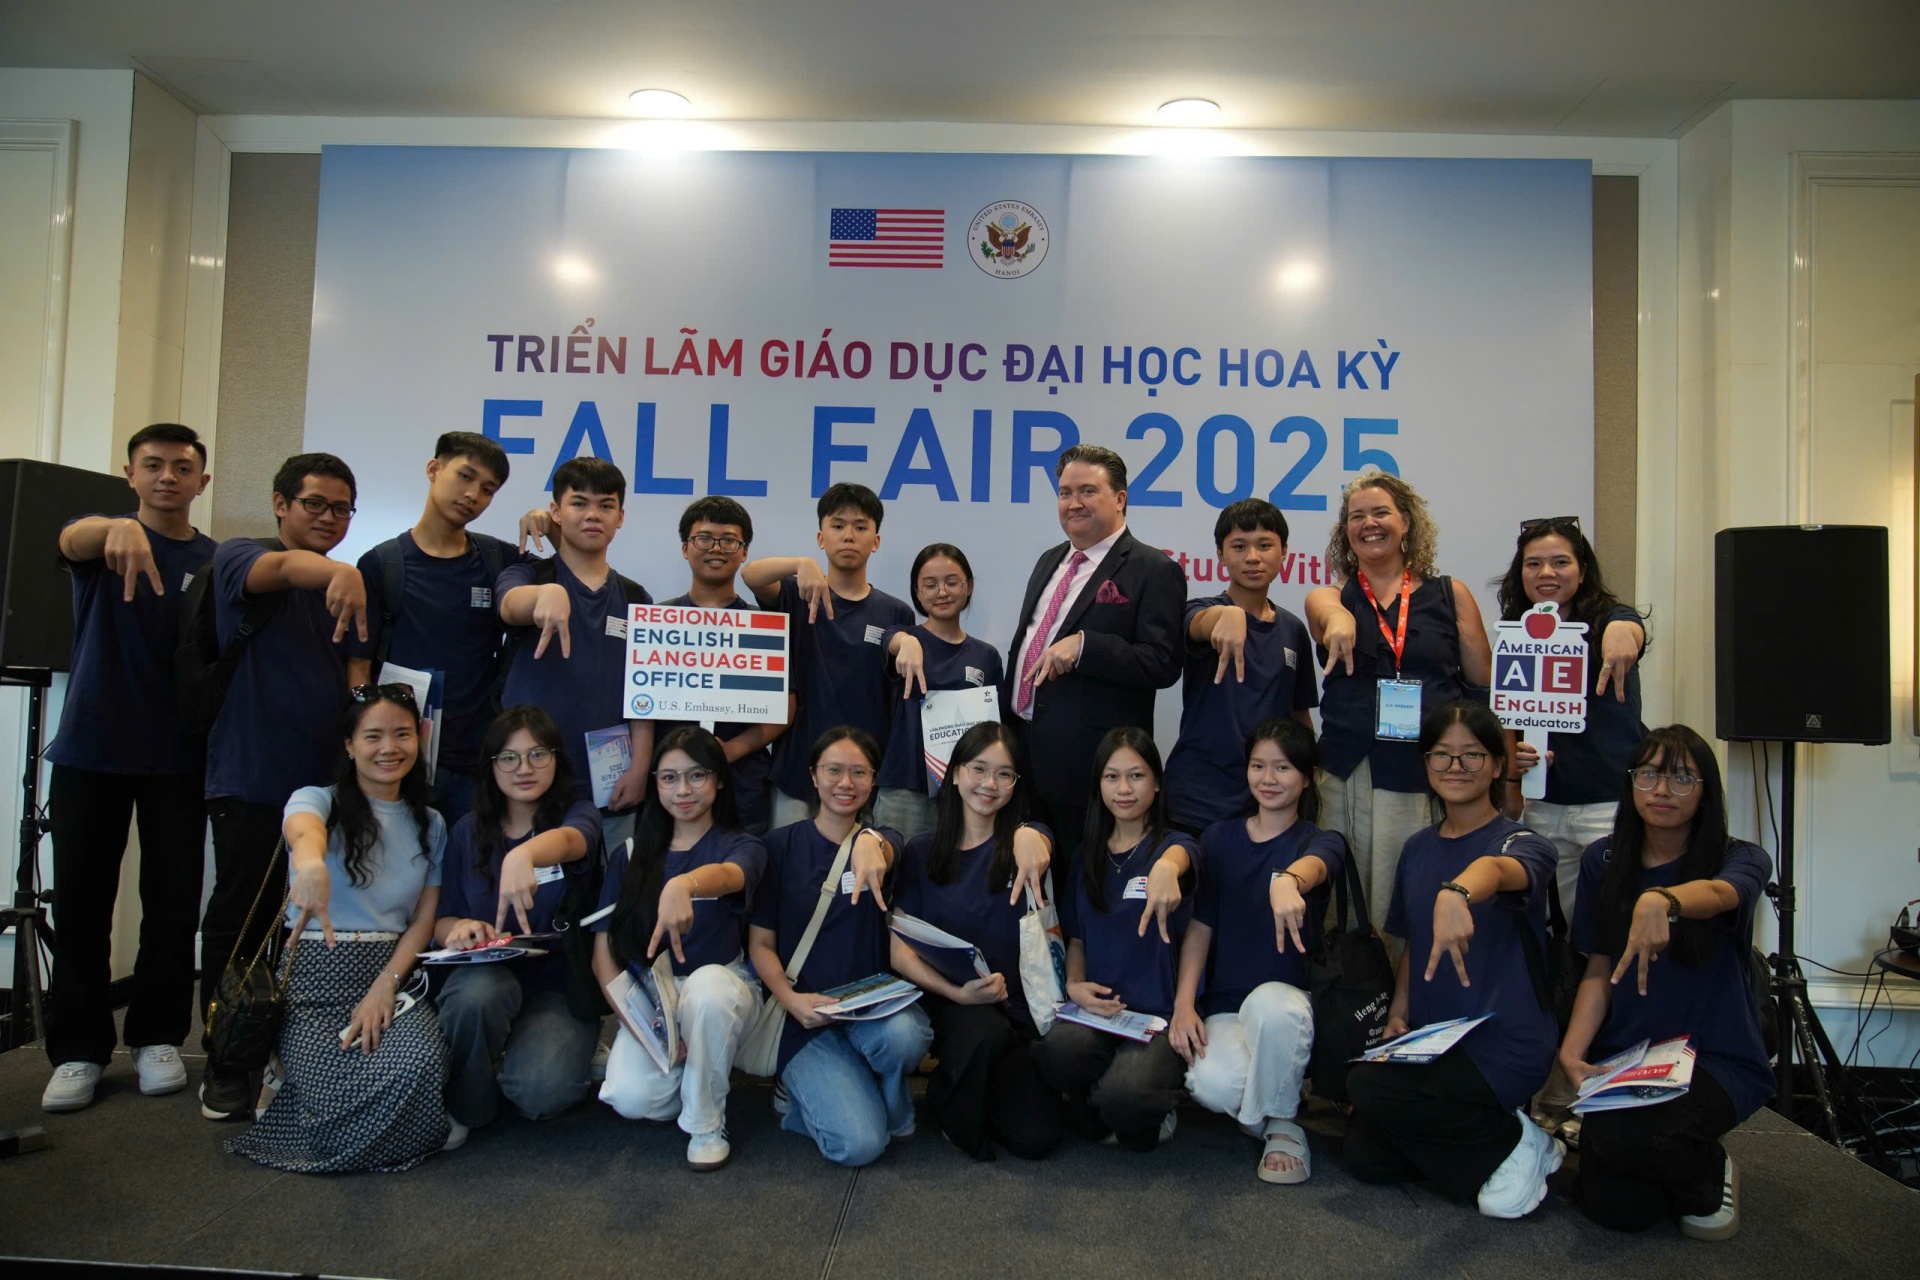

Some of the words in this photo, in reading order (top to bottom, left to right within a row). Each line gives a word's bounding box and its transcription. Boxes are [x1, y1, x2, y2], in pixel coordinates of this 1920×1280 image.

[973, 208, 993, 231] UNITED
[993, 203, 1020, 211] STATES
[1020, 206, 1045, 231] EMBASSY
[995, 268, 1020, 276] HANOI
[487, 317, 627, 375] TRIỂN
[644, 327, 743, 377] LÃM
[760, 328, 873, 380] GIÁO
[889, 341, 988, 392] DỤC
[1003, 344, 1084, 394] ĐẠI
[1103, 346, 1202, 396] HỌC
[1219, 348, 1321, 389] HOA
[1337, 338, 1401, 391] KỲ
[481, 399, 768, 497] FALL
[811, 405, 1081, 504] FAIR
[1125, 412, 1401, 512] 2025
[634, 607, 747, 628] REGIONAL
[633, 628, 734, 648] ENGLISH
[1497, 640, 1584, 655] AMERICAN
[632, 649, 763, 670] LANGUAGE
[632, 670, 714, 689] OFFICE
[1502, 660, 1528, 687] A
[1552, 661, 1572, 689] E
[658, 701, 682, 712] U.S.
[684, 702, 734, 715] Embassy,
[738, 704, 769, 715] Hanoi
[1494, 694, 1582, 715] ENGLISH
[1498, 717, 1511, 725] or
[1515, 717, 1581, 729] educators
